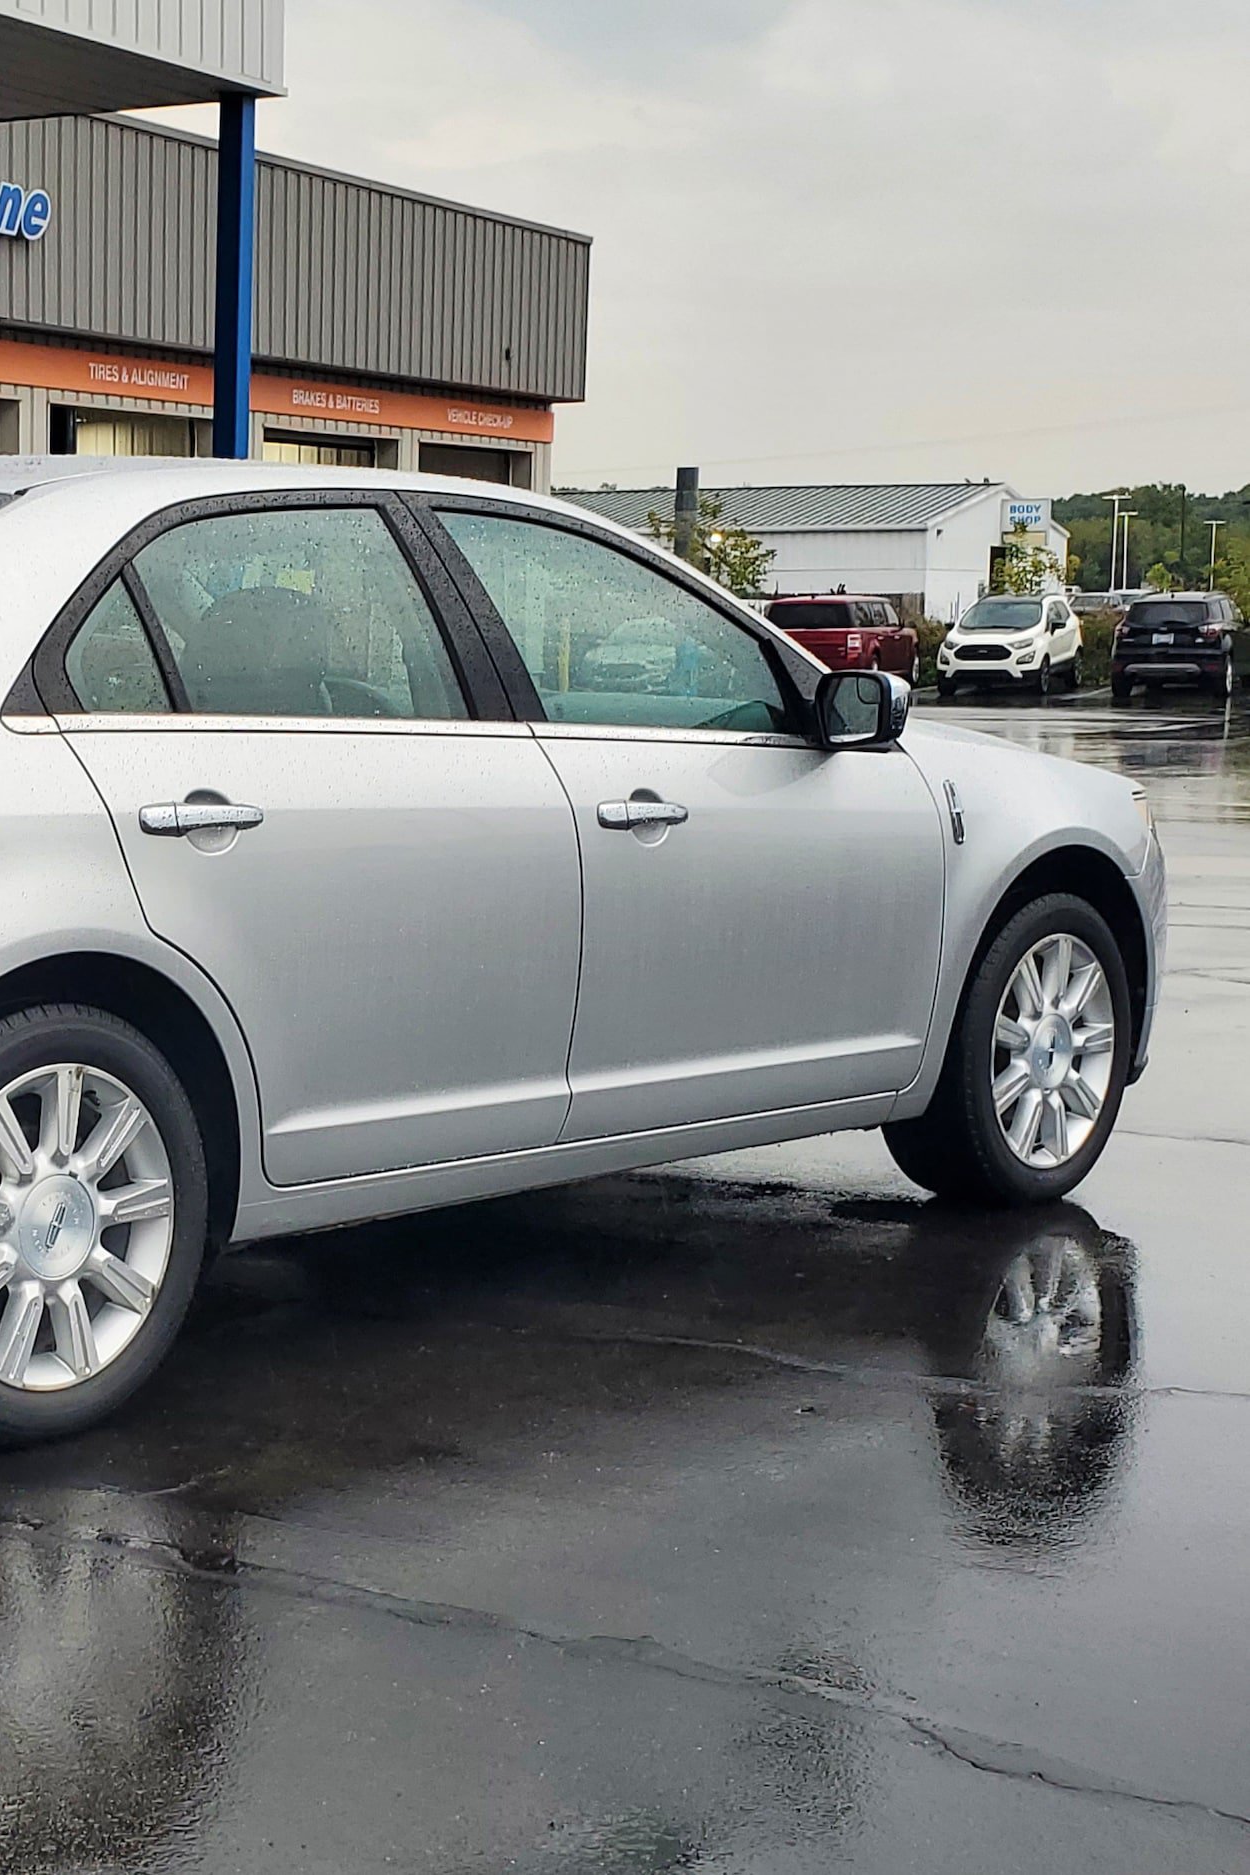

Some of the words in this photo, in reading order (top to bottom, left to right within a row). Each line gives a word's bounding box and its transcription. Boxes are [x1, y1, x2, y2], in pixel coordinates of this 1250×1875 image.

[88, 362, 119, 383] TIRES
[121, 366, 129, 384] &
[130, 368, 190, 390] ALIGNMENT
[292, 389, 327, 408] BRAKES
[328, 394, 334, 409] &
[336, 394, 380, 414] BATTERIES
[447, 408, 477, 425] VEHICLE
[1009, 504, 1042, 514] BODY
[1009, 515, 1042, 525] SHOP
